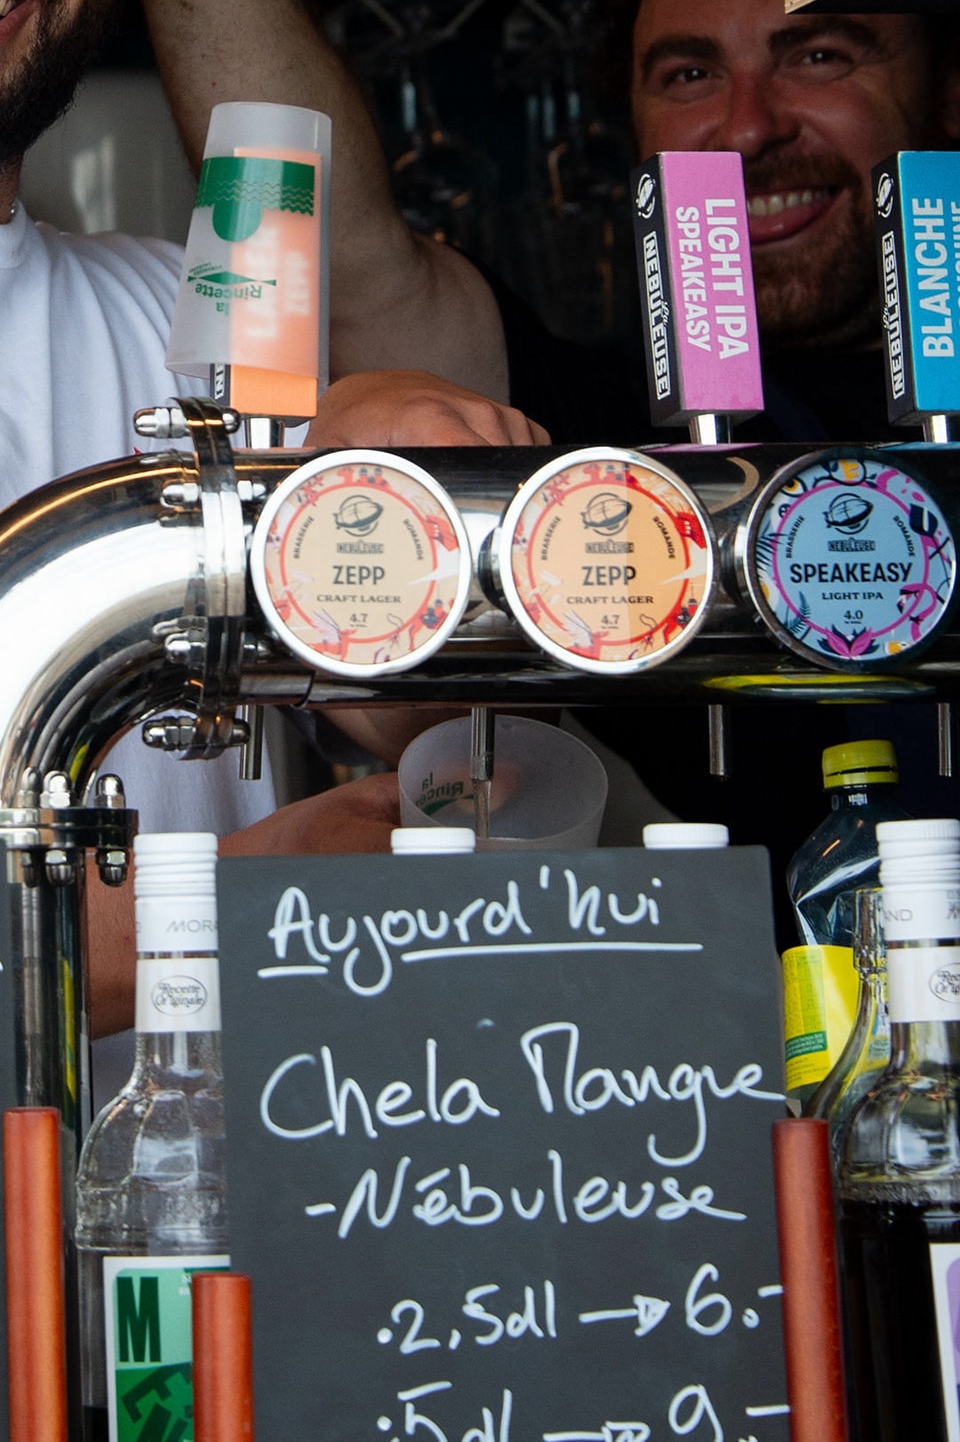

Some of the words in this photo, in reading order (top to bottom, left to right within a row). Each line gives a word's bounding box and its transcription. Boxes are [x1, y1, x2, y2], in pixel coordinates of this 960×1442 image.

[705, 199, 744, 296] LIGHT
[195, 283, 262, 300] Rincette
[675, 206, 712, 352] SPEAKEASY
[911, 198, 955, 358] BLANCHE
[215, 302, 230, 317] la
[644, 234, 669, 396] NEBULEUSE
[882, 234, 904, 396] NEBULEUSE
[715, 305, 750, 360] IPA
[294, 516, 314, 559] BRASSERIE
[403, 518, 424, 561] ROMANDE
[541, 515, 562, 561] BRASSERIE
[652, 515, 676, 559] ROMANDE
[786, 515, 806, 559] BRASSERIE
[892, 515, 916, 558] ROMANDE
[332, 565, 385, 585] ZEPP
[581, 566, 637, 586] ZEPP
[790, 562, 913, 584] SPEAKEASY
[317, 594, 357, 603] CRAFT
[360, 595, 402, 604] LAGER
[350, 613, 369, 622] 4.7
[566, 596, 609, 605] CRAFT
[612, 595, 654, 605] LAGER
[822, 592, 860, 601] LIGHT
[862, 592, 884, 600] IPA
[844, 610, 864, 620] 4.0
[601, 614, 620, 625] 4.7
[268, 865, 662, 996] Aujourd'hui
[261, 1037, 500, 1139] Chela
[520, 1021, 786, 1167] Mangue
